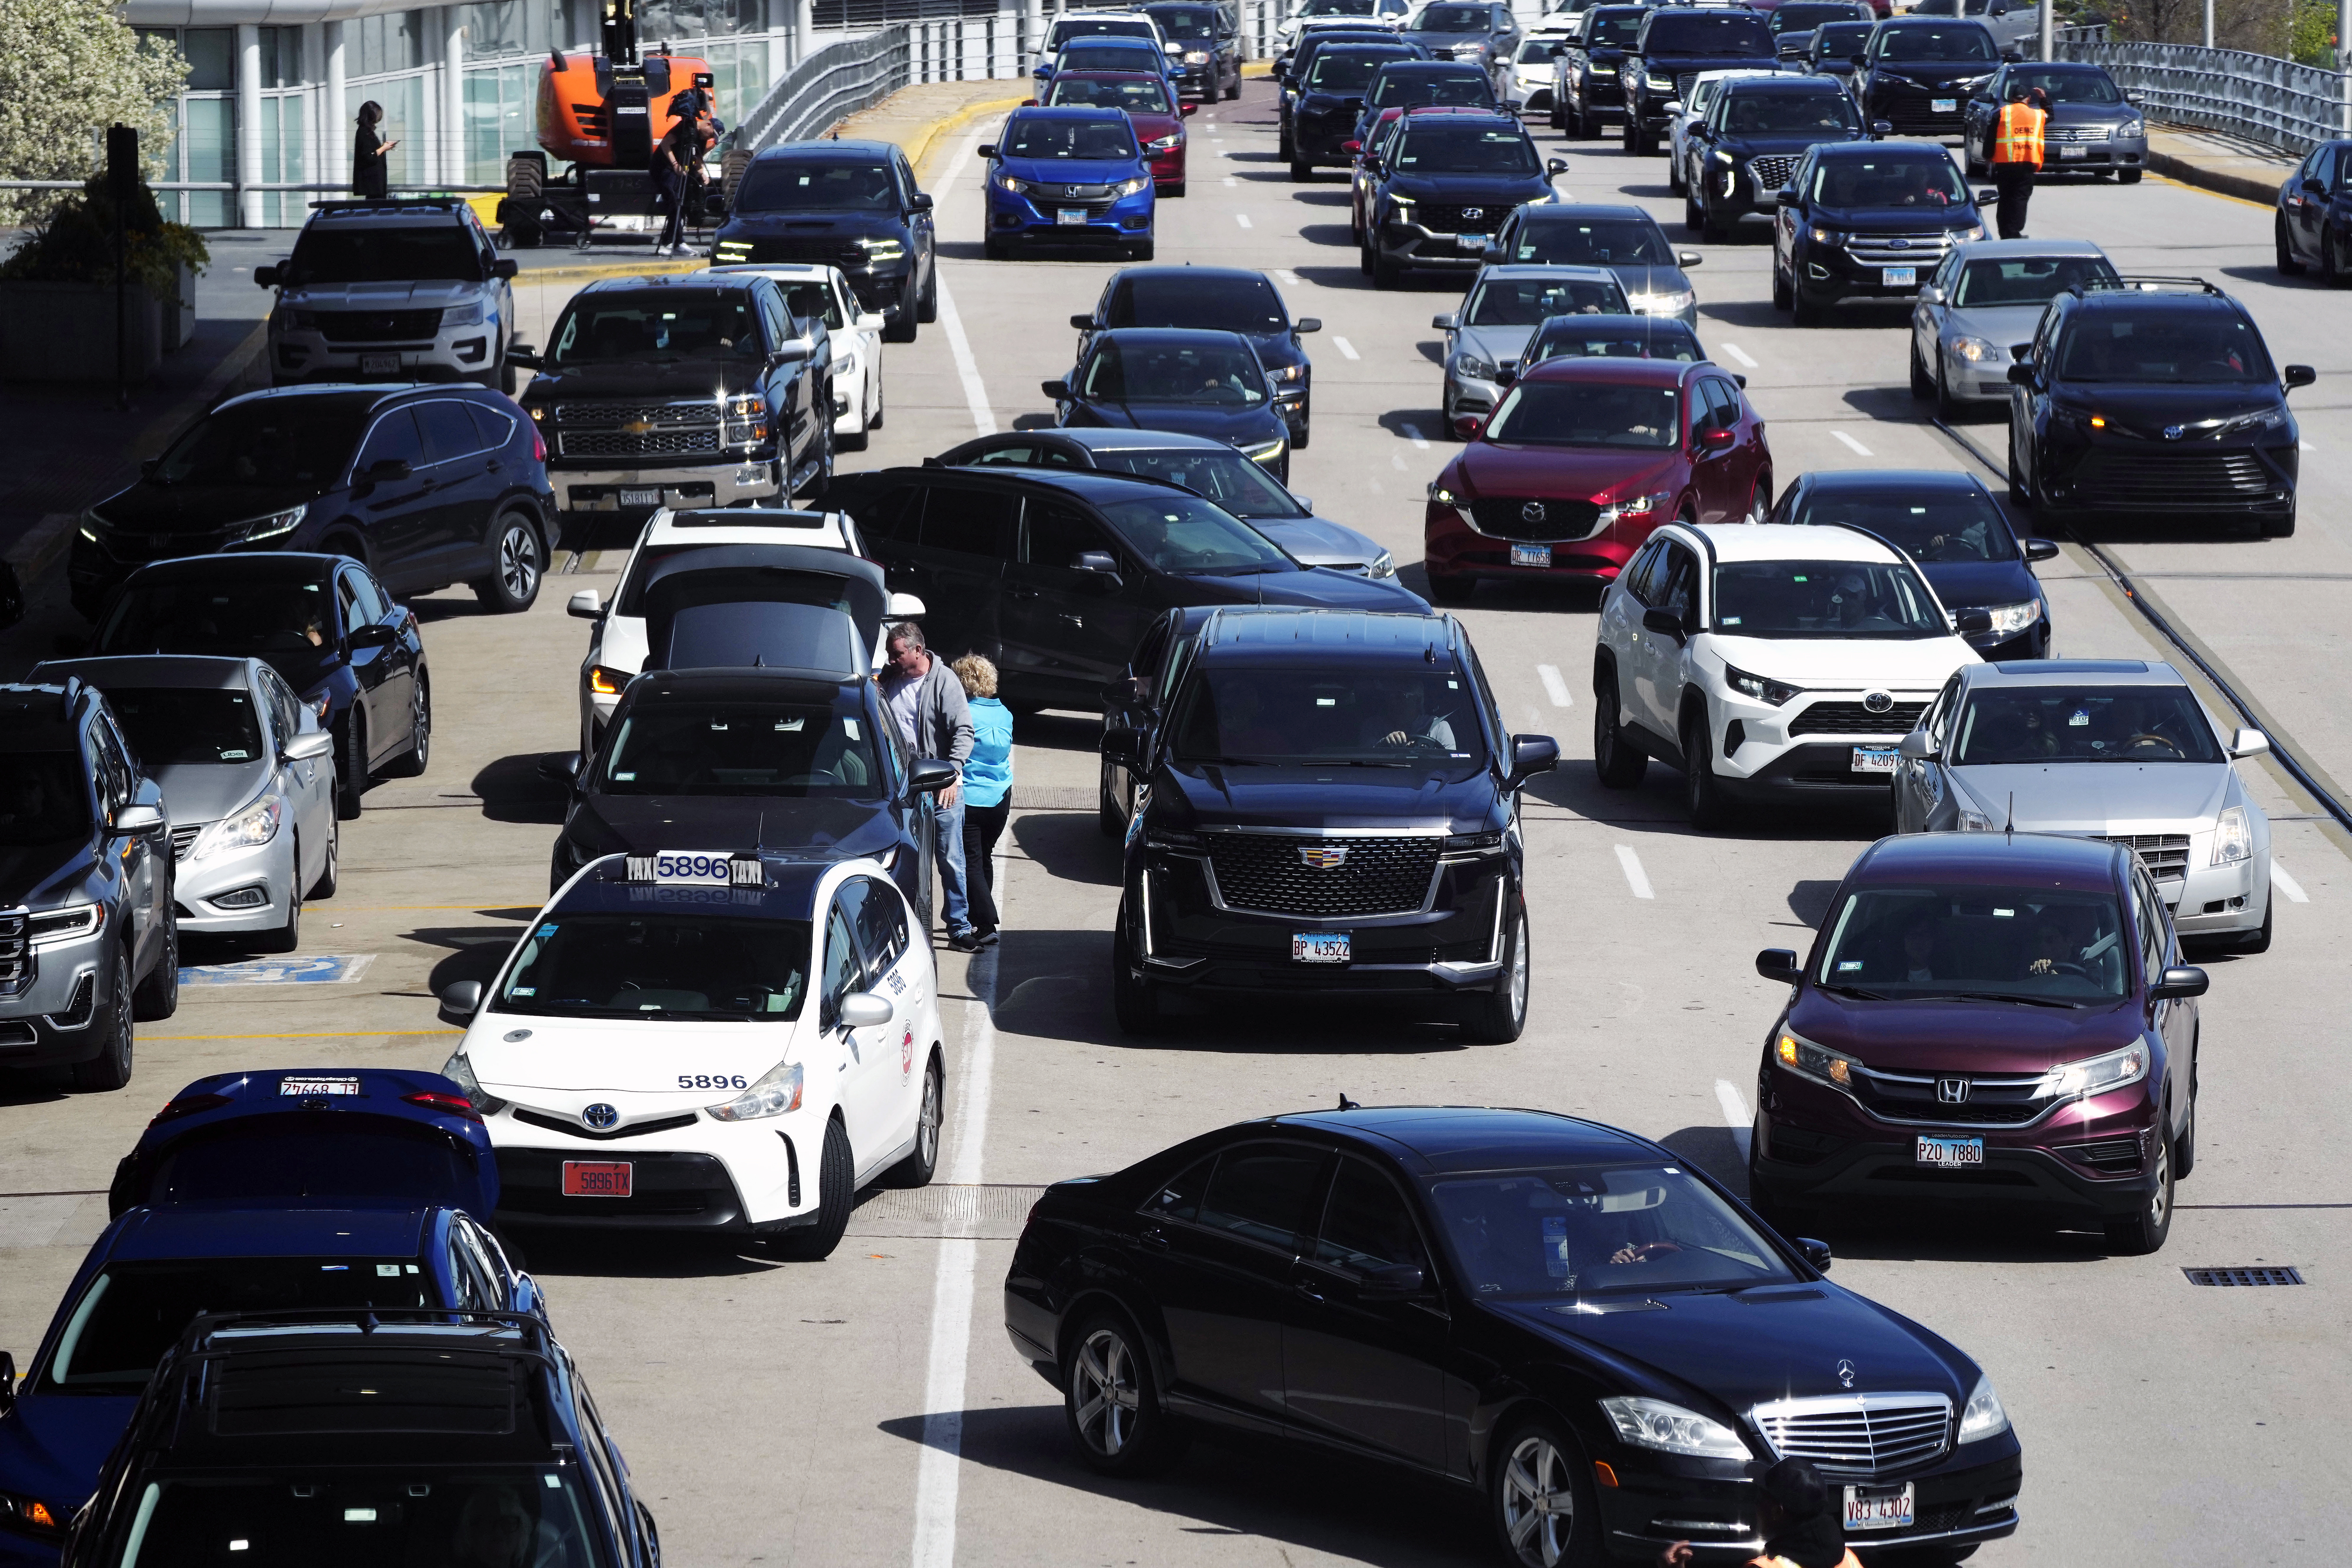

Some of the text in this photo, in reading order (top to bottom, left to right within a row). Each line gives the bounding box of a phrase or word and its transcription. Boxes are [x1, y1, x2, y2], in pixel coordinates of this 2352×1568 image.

[1512, 550, 1550, 562] DR 77658
[1855, 754, 1900, 767] DF 42097
[626, 856, 763, 884] TAXI 5896 TAXI
[1294, 941, 1349, 956] BP 43522
[887, 968, 906, 996] 5896
[903, 1041, 912, 1065] SUN
[679, 1076, 747, 1089] 5896
[1919, 1143, 1981, 1162] P20 7880
[581, 1172, 629, 1190] 5896TX
[1848, 1497, 1910, 1521] V83 4302
